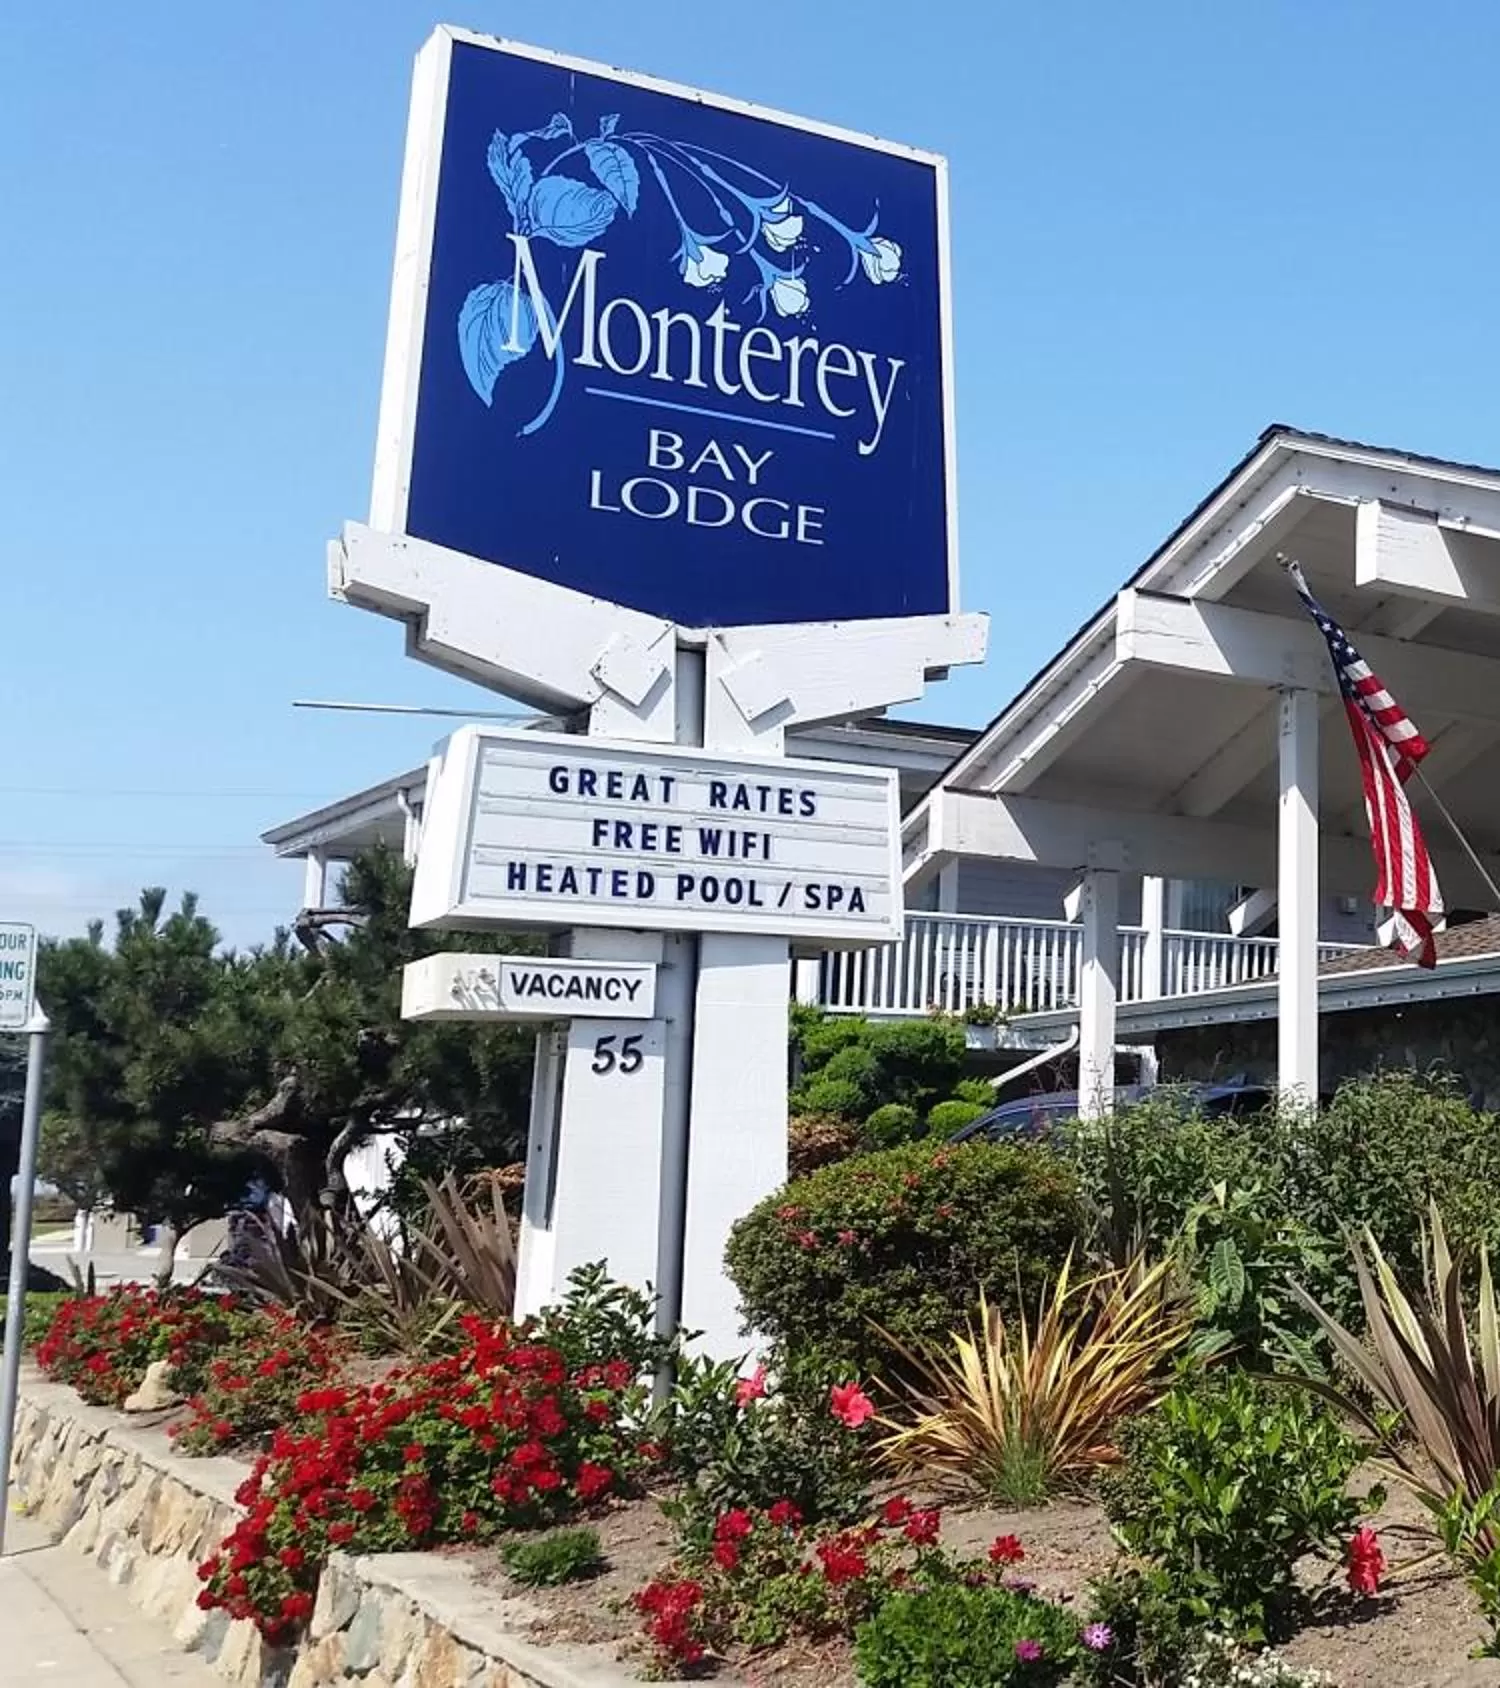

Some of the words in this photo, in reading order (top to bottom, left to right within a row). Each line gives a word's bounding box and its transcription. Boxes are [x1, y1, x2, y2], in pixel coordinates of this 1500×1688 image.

[500, 232, 905, 455] Monterey
[647, 428, 774, 485] BAY
[590, 469, 825, 545] LODGE
[548, 765, 676, 804] GREAT
[708, 780, 818, 818] RATES
[591, 818, 683, 854] FREE
[697, 827, 772, 860] WIFI
[506, 861, 656, 900] HEATED
[509, 971, 643, 1002] VACANCY
[590, 1033, 645, 1076] 55
